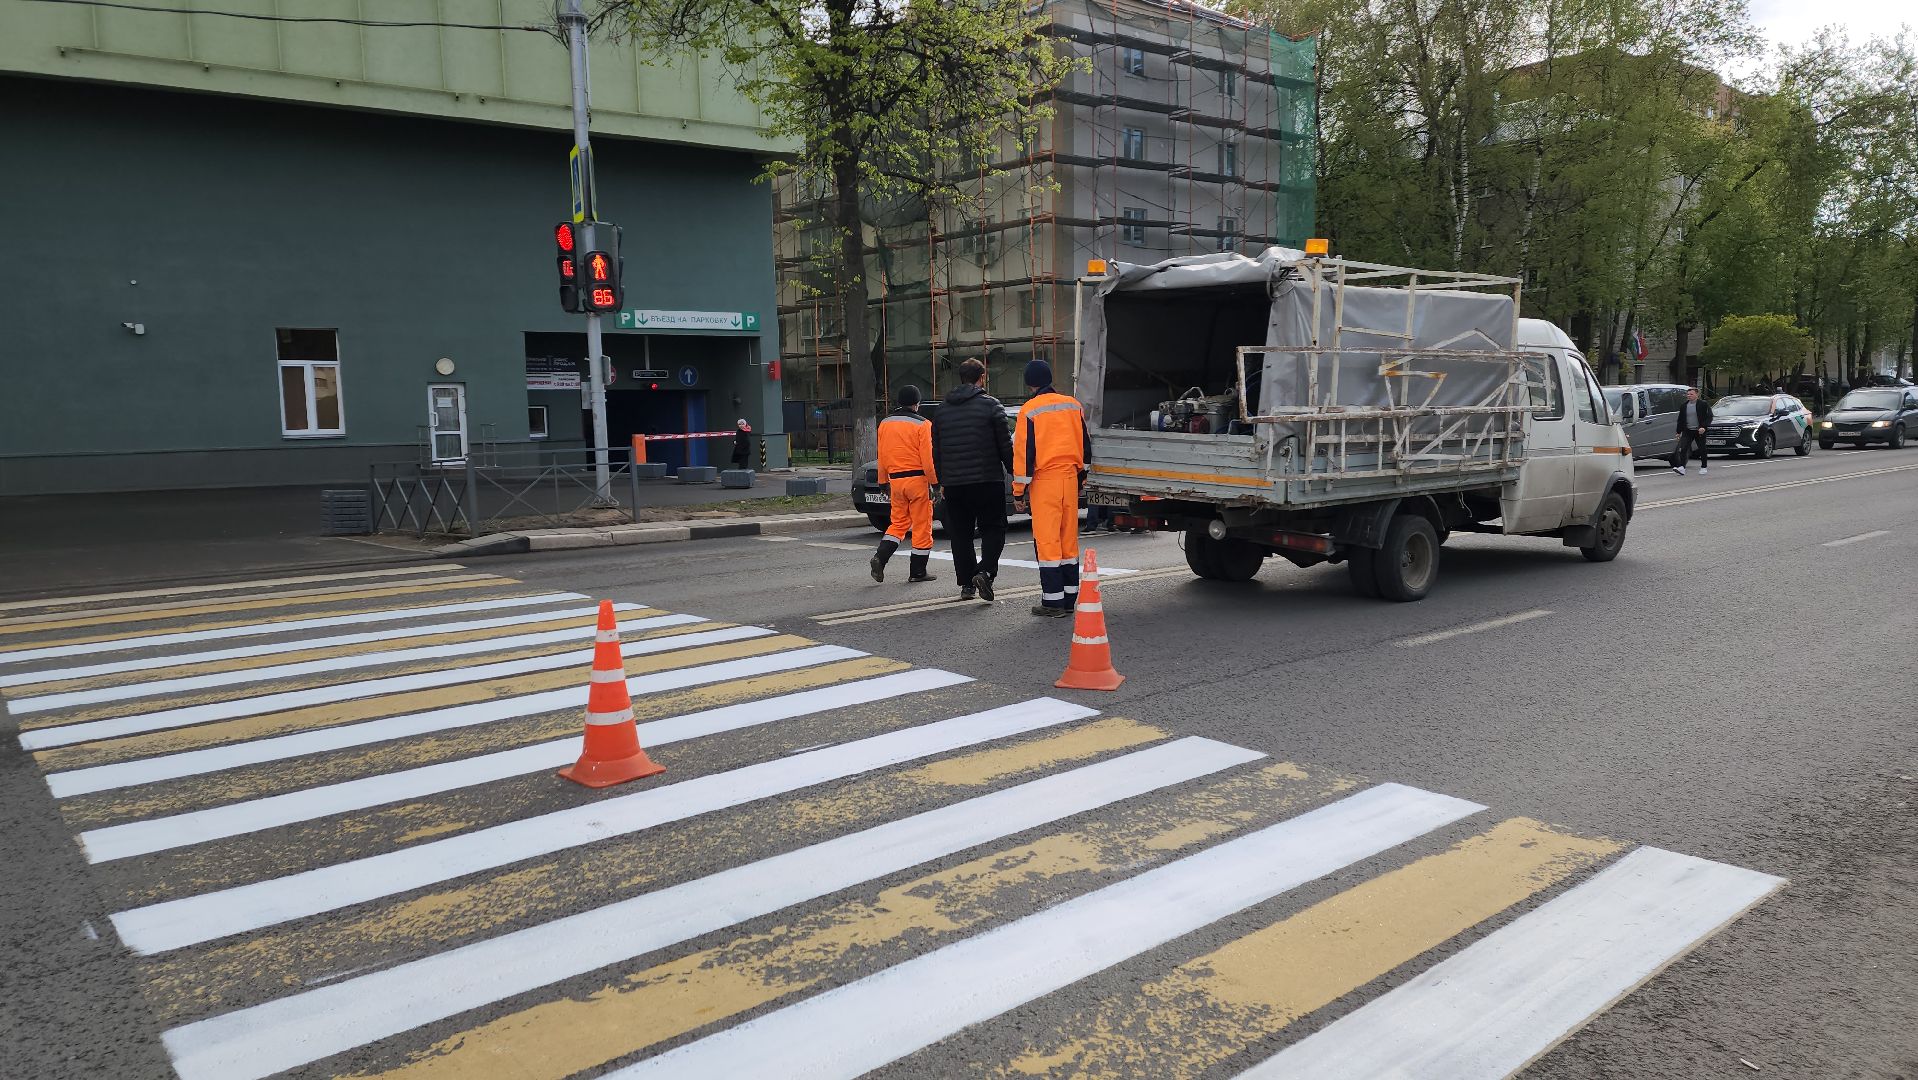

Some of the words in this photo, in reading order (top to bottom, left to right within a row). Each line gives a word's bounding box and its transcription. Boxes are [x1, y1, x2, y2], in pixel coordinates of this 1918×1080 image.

[620, 312, 631, 325] P
[650, 315, 676, 324] ВЪЕЗД
[690, 316, 728, 324] ПАРКОВКУ
[746, 315, 755, 328] P
